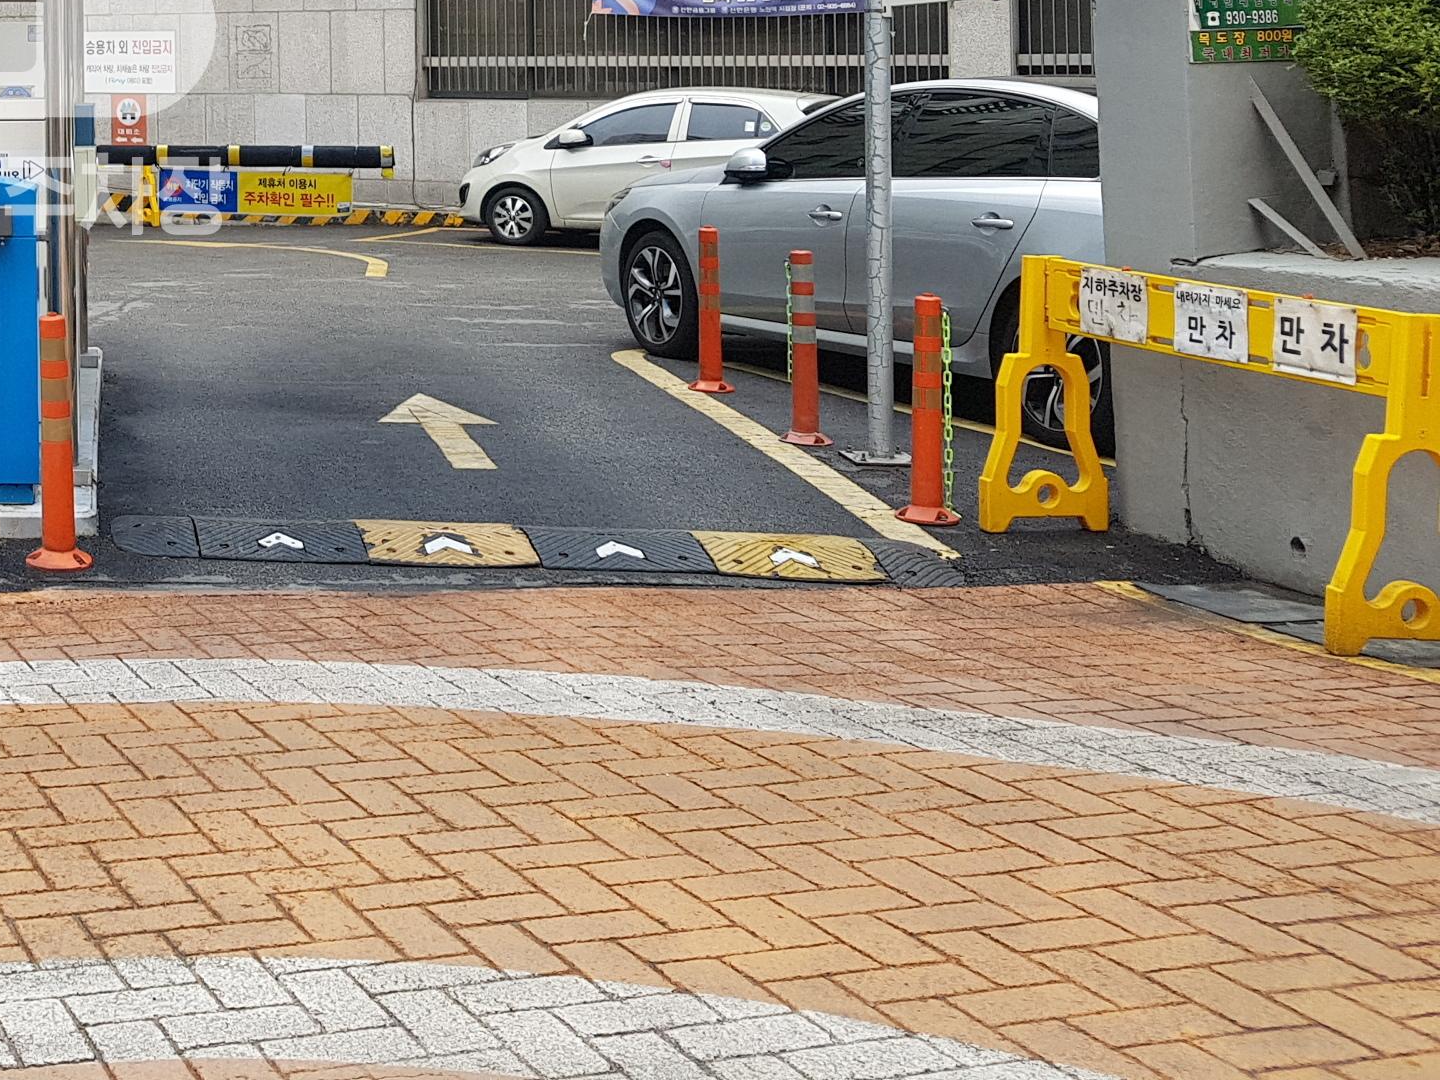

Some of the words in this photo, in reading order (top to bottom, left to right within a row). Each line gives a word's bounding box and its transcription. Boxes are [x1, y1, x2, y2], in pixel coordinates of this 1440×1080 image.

[1226, 10, 1279, 24] 930-9386
[1256, 29, 1293, 43] 800원
[289, 178, 317, 189] 이용시
[244, 191, 295, 208] 주차확인
[300, 192, 335, 208] 필수!!
[1082, 276, 1143, 303] 지하주차장
